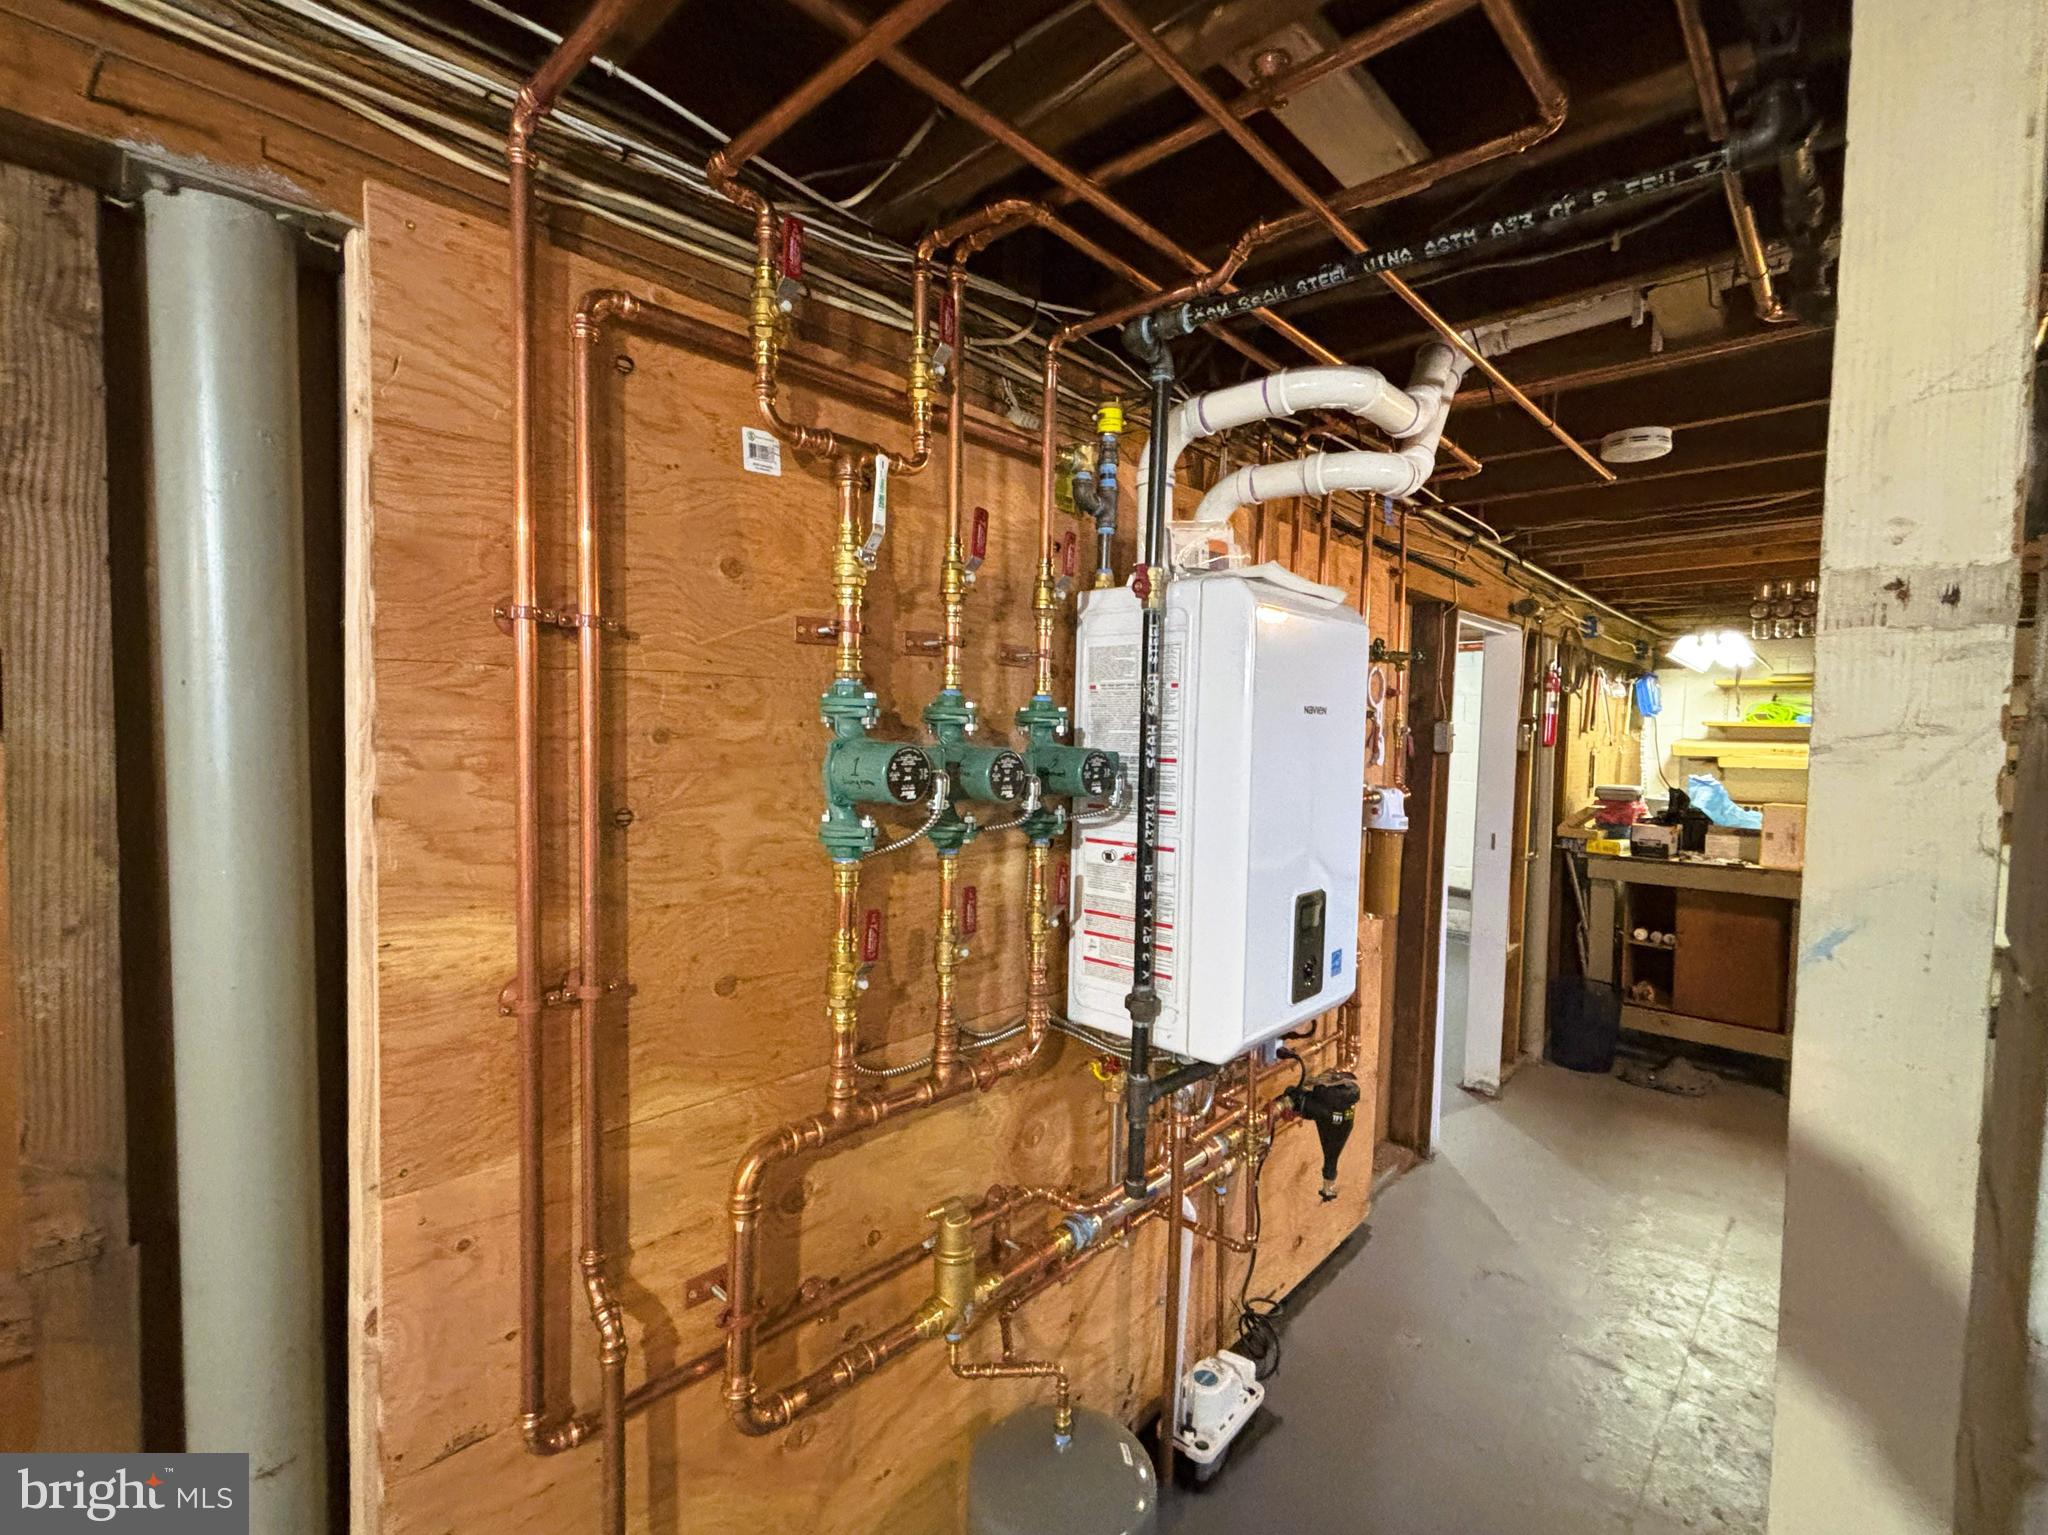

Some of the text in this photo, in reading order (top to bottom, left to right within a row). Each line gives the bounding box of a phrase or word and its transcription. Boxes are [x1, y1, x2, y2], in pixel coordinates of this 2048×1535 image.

[1296, 264, 1351, 294] STEEL
[1145, 795, 1156, 847] 437341
[1143, 908, 1153, 918] X
